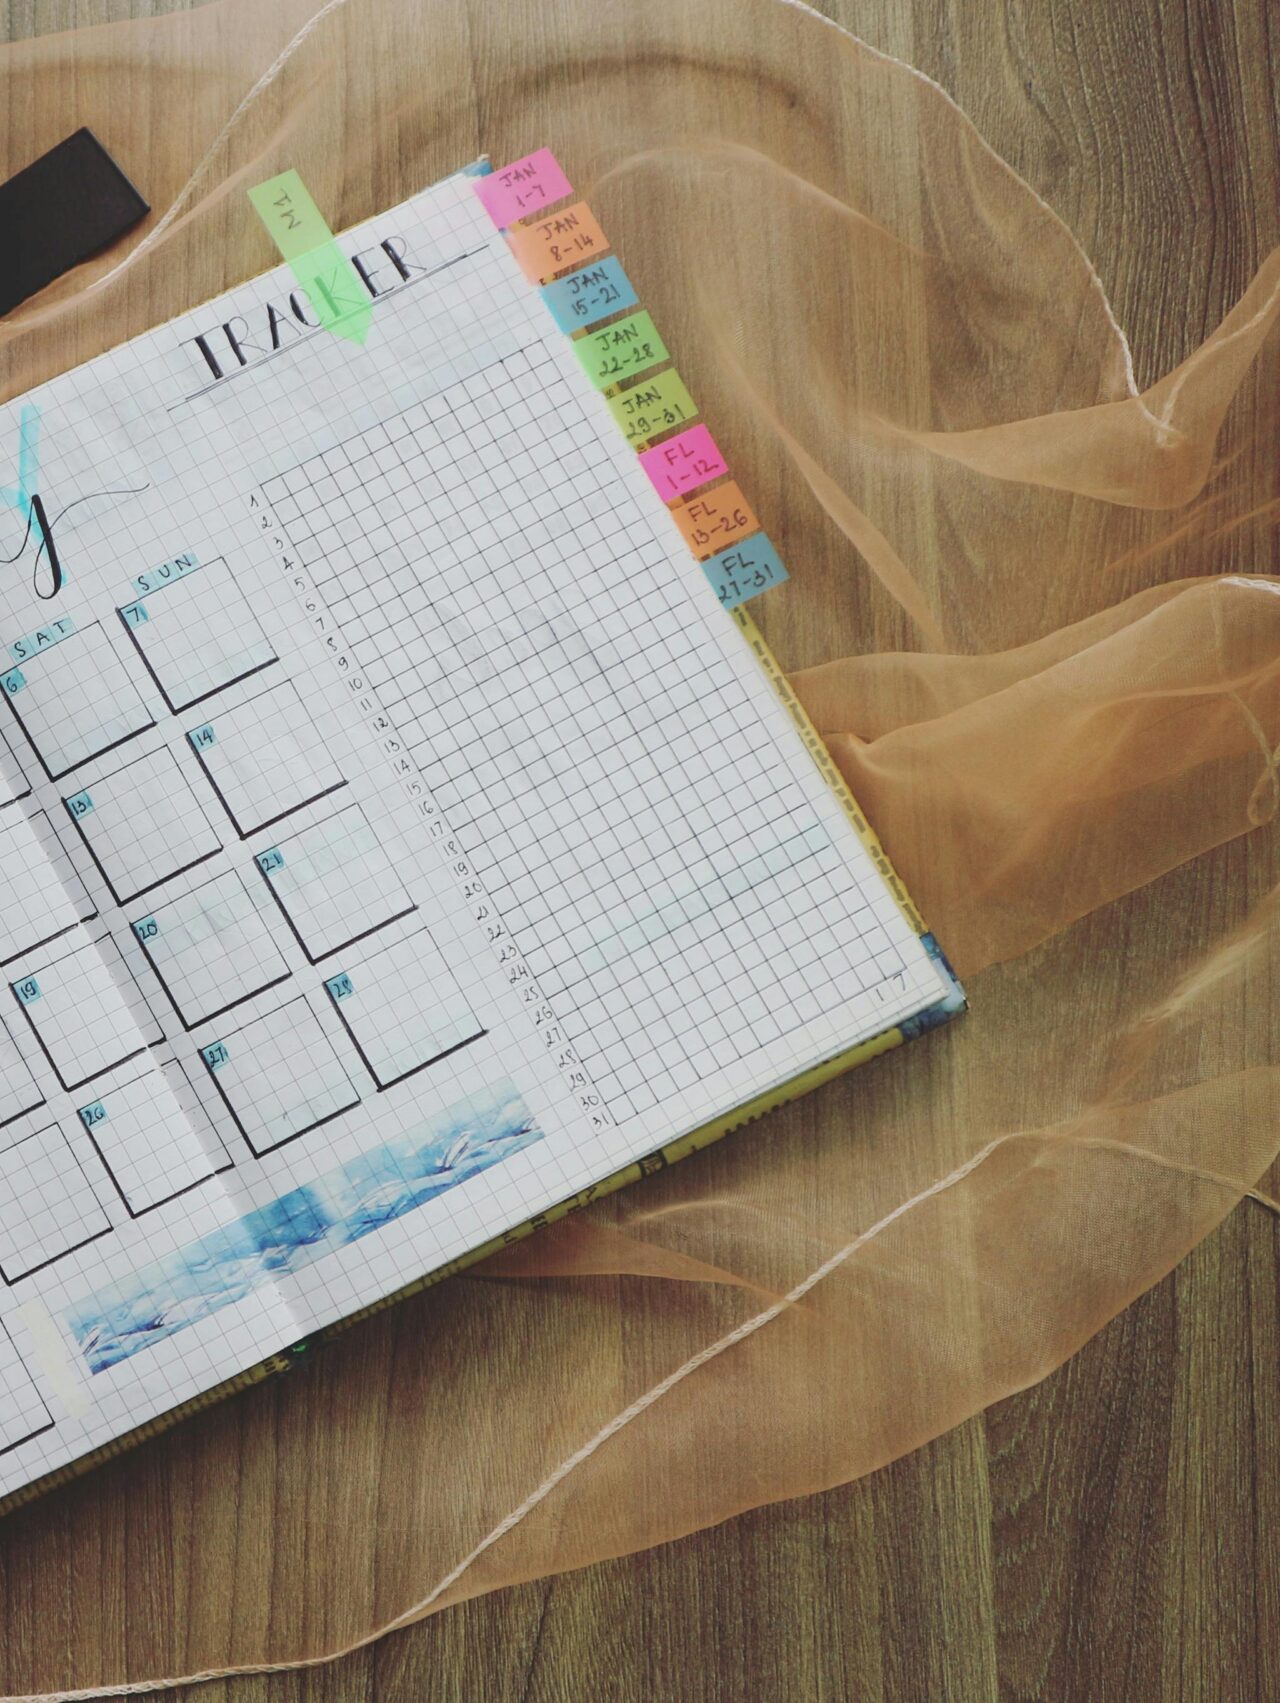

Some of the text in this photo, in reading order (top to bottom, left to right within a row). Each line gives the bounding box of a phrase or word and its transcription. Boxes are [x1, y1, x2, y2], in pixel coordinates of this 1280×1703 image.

[499, 162, 537, 187] JAN
[537, 213, 579, 240] JAN
[566, 267, 608, 294] JAN
[178, 236, 427, 380] TRACKER
[595, 323, 639, 351] JAN
[622, 386, 662, 414] JAN
[664, 442, 695, 466] FL
[250, 494, 259, 507] 1
[688, 502, 717, 522] FL
[261, 516, 272, 529] 2
[273, 537, 283, 550] 3
[282, 556, 294, 570] 4
[722, 552, 755, 576] FL
[137, 555, 192, 591] SUN
[294, 577, 305, 591] 5
[305, 598, 316, 612] 6
[126, 607, 141, 622] 7
[315, 617, 324, 630] 7
[13, 621, 67, 658] SAT
[326, 637, 337, 652] 8
[338, 656, 349, 671] 9
[6, 677, 18, 693] 6
[348, 677, 363, 691] 10
[360, 698, 372, 711] 11
[373, 717, 388, 732] 12
[196, 731, 213, 746] 14
[384, 739, 400, 753] 13
[393, 759, 410, 775] 14
[406, 781, 421, 795] 15
[71, 799, 88, 816] 13
[418, 801, 434, 816] 16
[430, 821, 444, 837] 17
[443, 841, 458, 856] 18
[262, 855, 280, 872] 21
[453, 862, 469, 877] 19
[465, 882, 482, 898] 20
[139, 922, 158, 940] 20
[487, 924, 506, 943] 22
[500, 945, 517, 963] 23
[509, 964, 528, 984] 24
[20, 983, 37, 1000] 19
[332, 979, 352, 998] 28
[524, 986, 539, 1002] 25
[875, 972, 906, 1001] 17
[536, 1006, 553, 1025] 26
[546, 1027, 561, 1048] 27
[559, 1049, 576, 1068] 28
[569, 1072, 587, 1092] 29
[580, 1095, 599, 1111] 30
[85, 1108, 104, 1127] 26
[592, 1111, 609, 1129] 31
